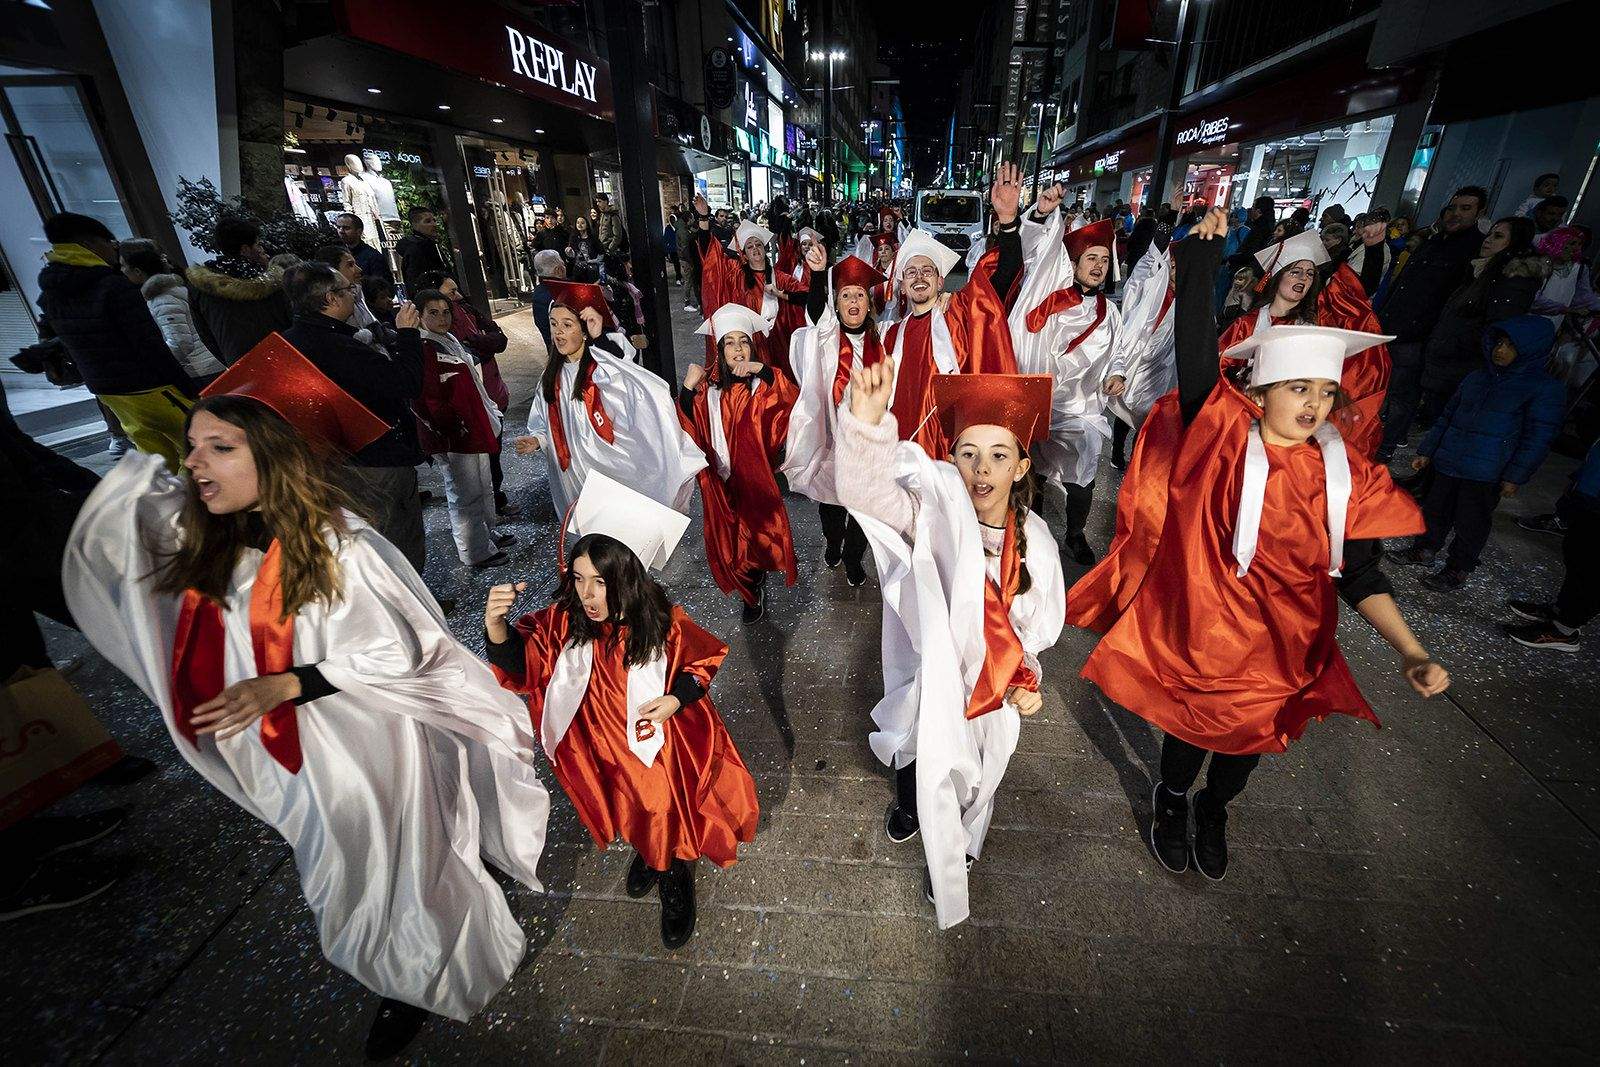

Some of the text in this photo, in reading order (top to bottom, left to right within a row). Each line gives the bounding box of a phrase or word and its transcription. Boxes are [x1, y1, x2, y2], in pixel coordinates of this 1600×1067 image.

[505, 25, 598, 103] REPLAY
[1176, 127, 1199, 145] ROCA
[1201, 116, 1229, 136] RIBES
[593, 411, 604, 427] B
[634, 718, 656, 742] B
